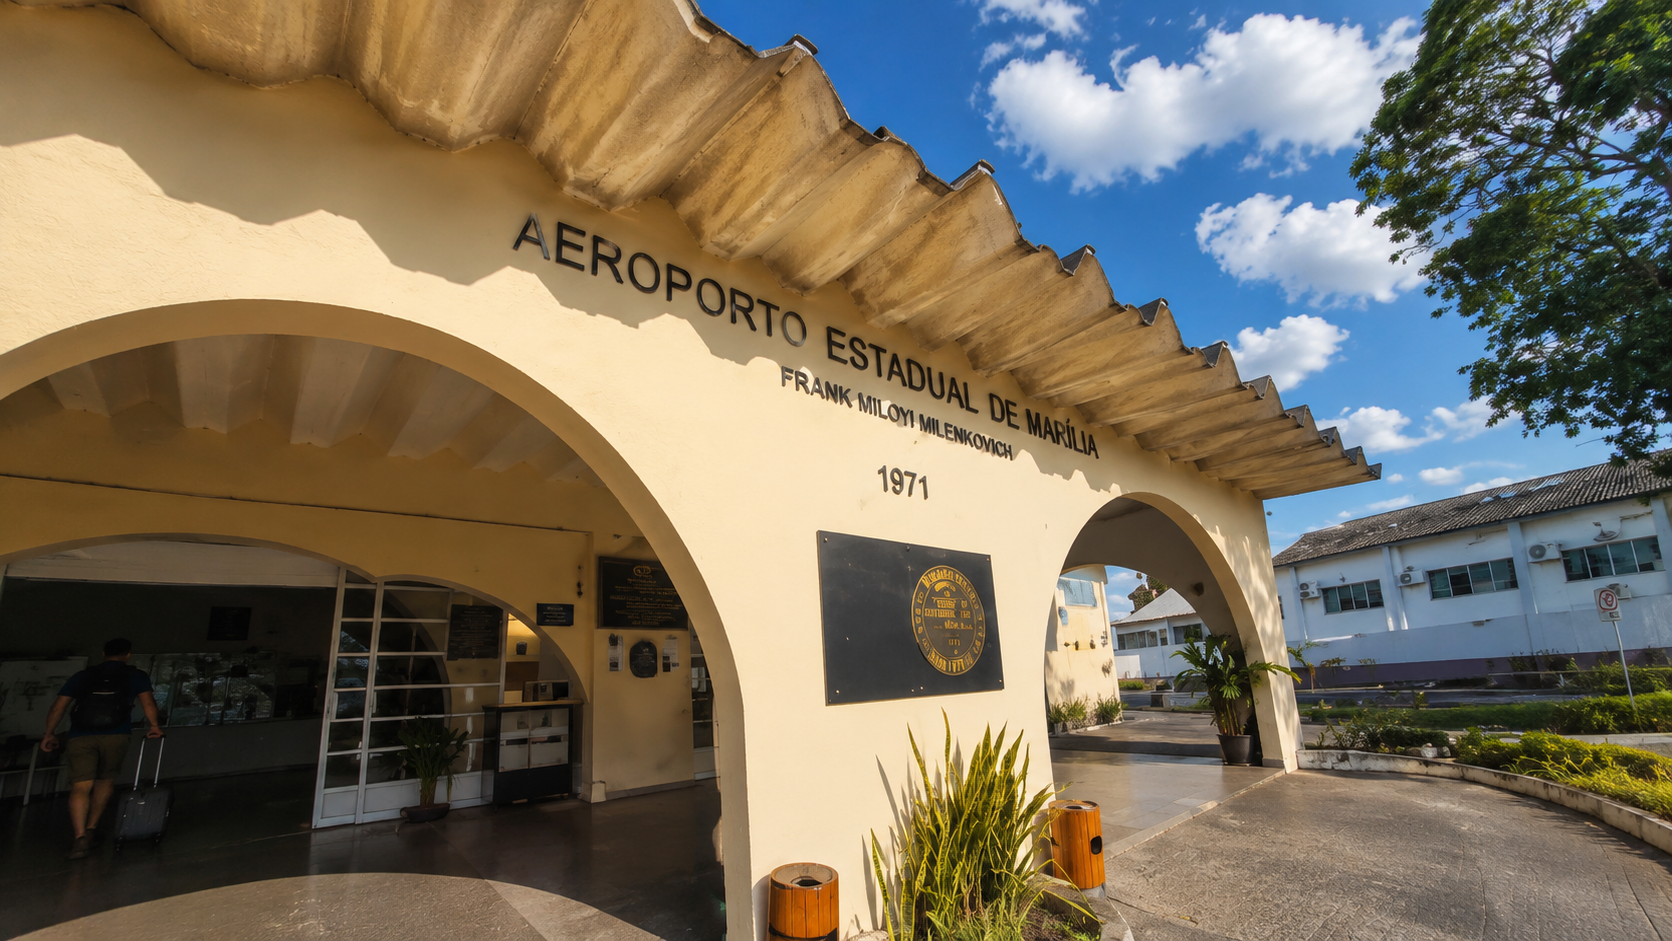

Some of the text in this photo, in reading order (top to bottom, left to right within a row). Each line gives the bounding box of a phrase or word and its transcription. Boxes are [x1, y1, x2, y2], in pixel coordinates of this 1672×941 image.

[512, 212, 1099, 459] AEROPORTO ESTADUAL DE MARÍLIA
[781, 366, 1013, 460] FRANK MILOYI MILENKOVICH
[877, 465, 929, 500] 1971
